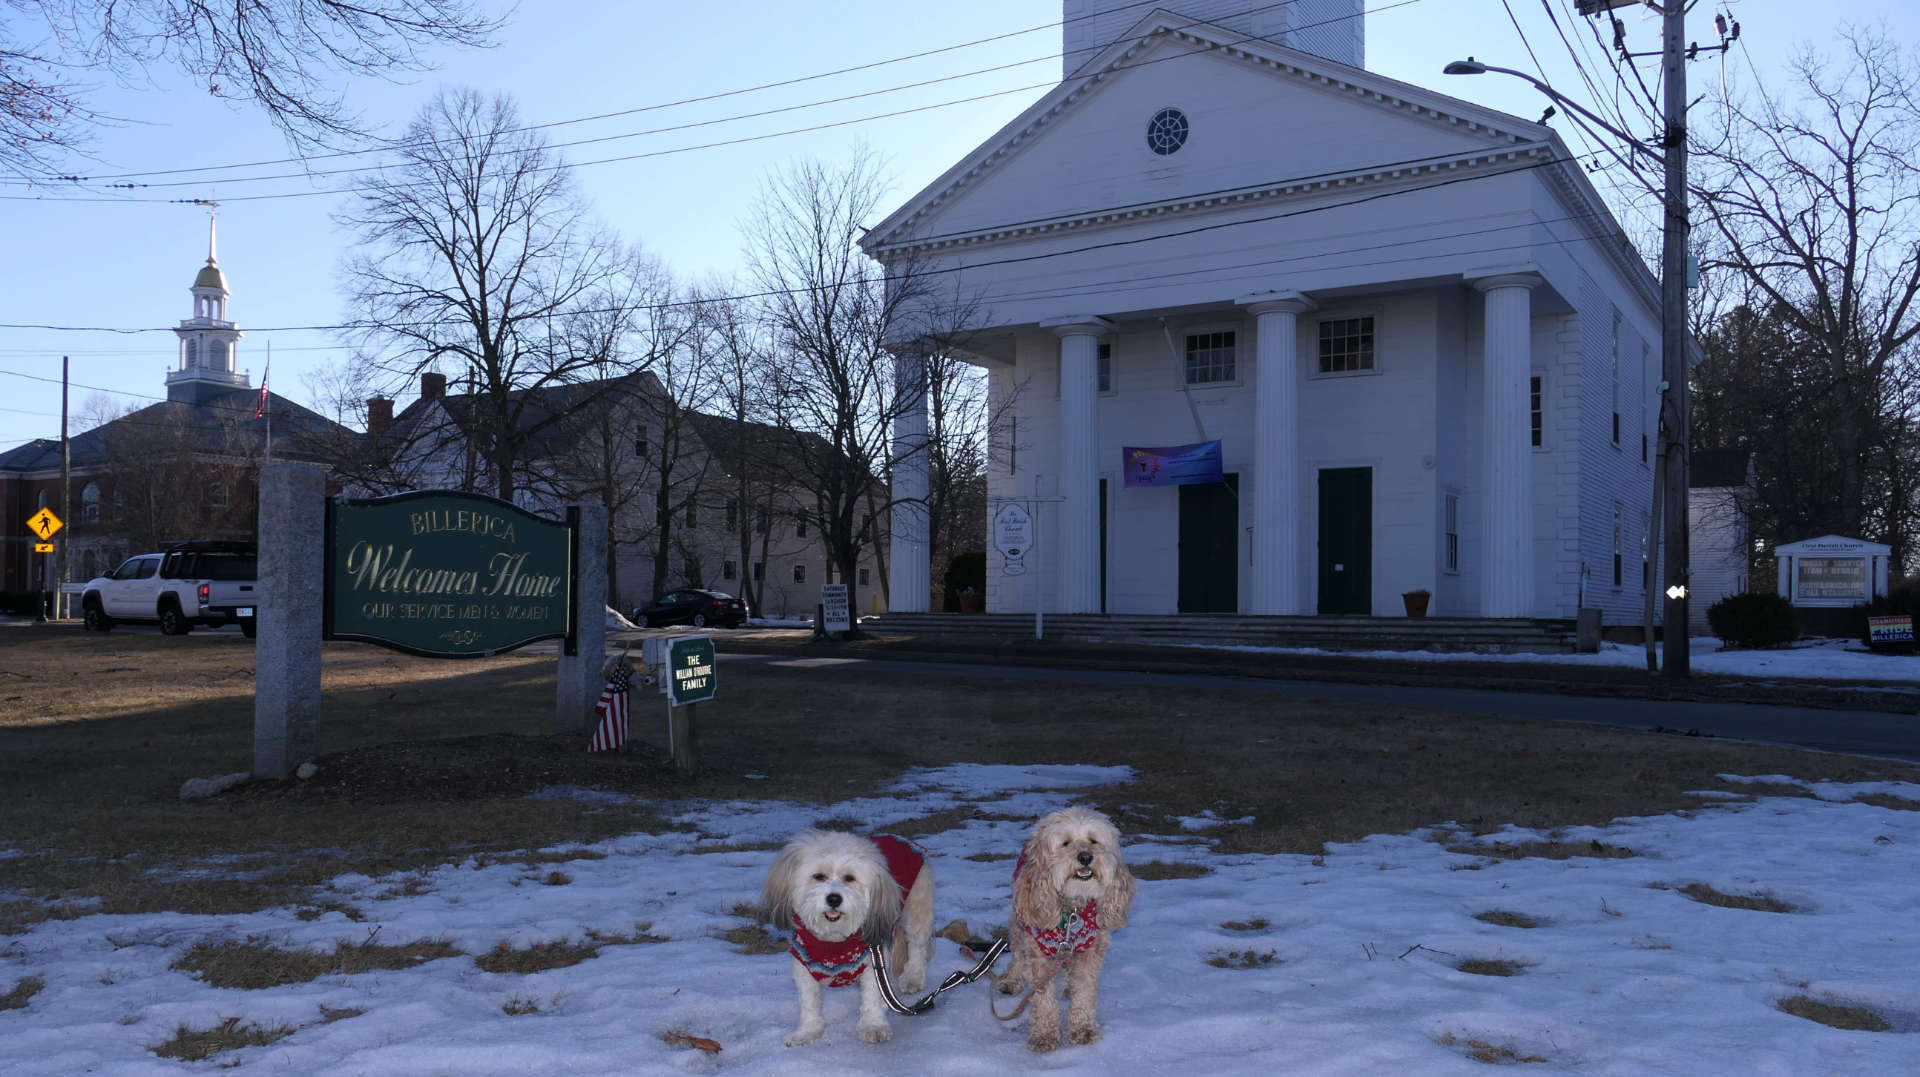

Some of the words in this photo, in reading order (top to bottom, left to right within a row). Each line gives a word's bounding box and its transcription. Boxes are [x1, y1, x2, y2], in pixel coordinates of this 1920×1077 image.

[410, 510, 516, 543] BILLERICA
[347, 540, 480, 593] Welcomes
[482, 552, 561, 598] Home
[362, 603, 395, 619] OUR
[399, 603, 456, 620] SERVICE
[459, 604, 488, 620] MEN
[506, 604, 549, 620] WOMEN
[1871, 623, 1913, 634] PRIDE
[1872, 633, 1913, 641] BILLERICA
[688, 655, 700, 666] THE
[682, 678, 706, 691] FAMILY
